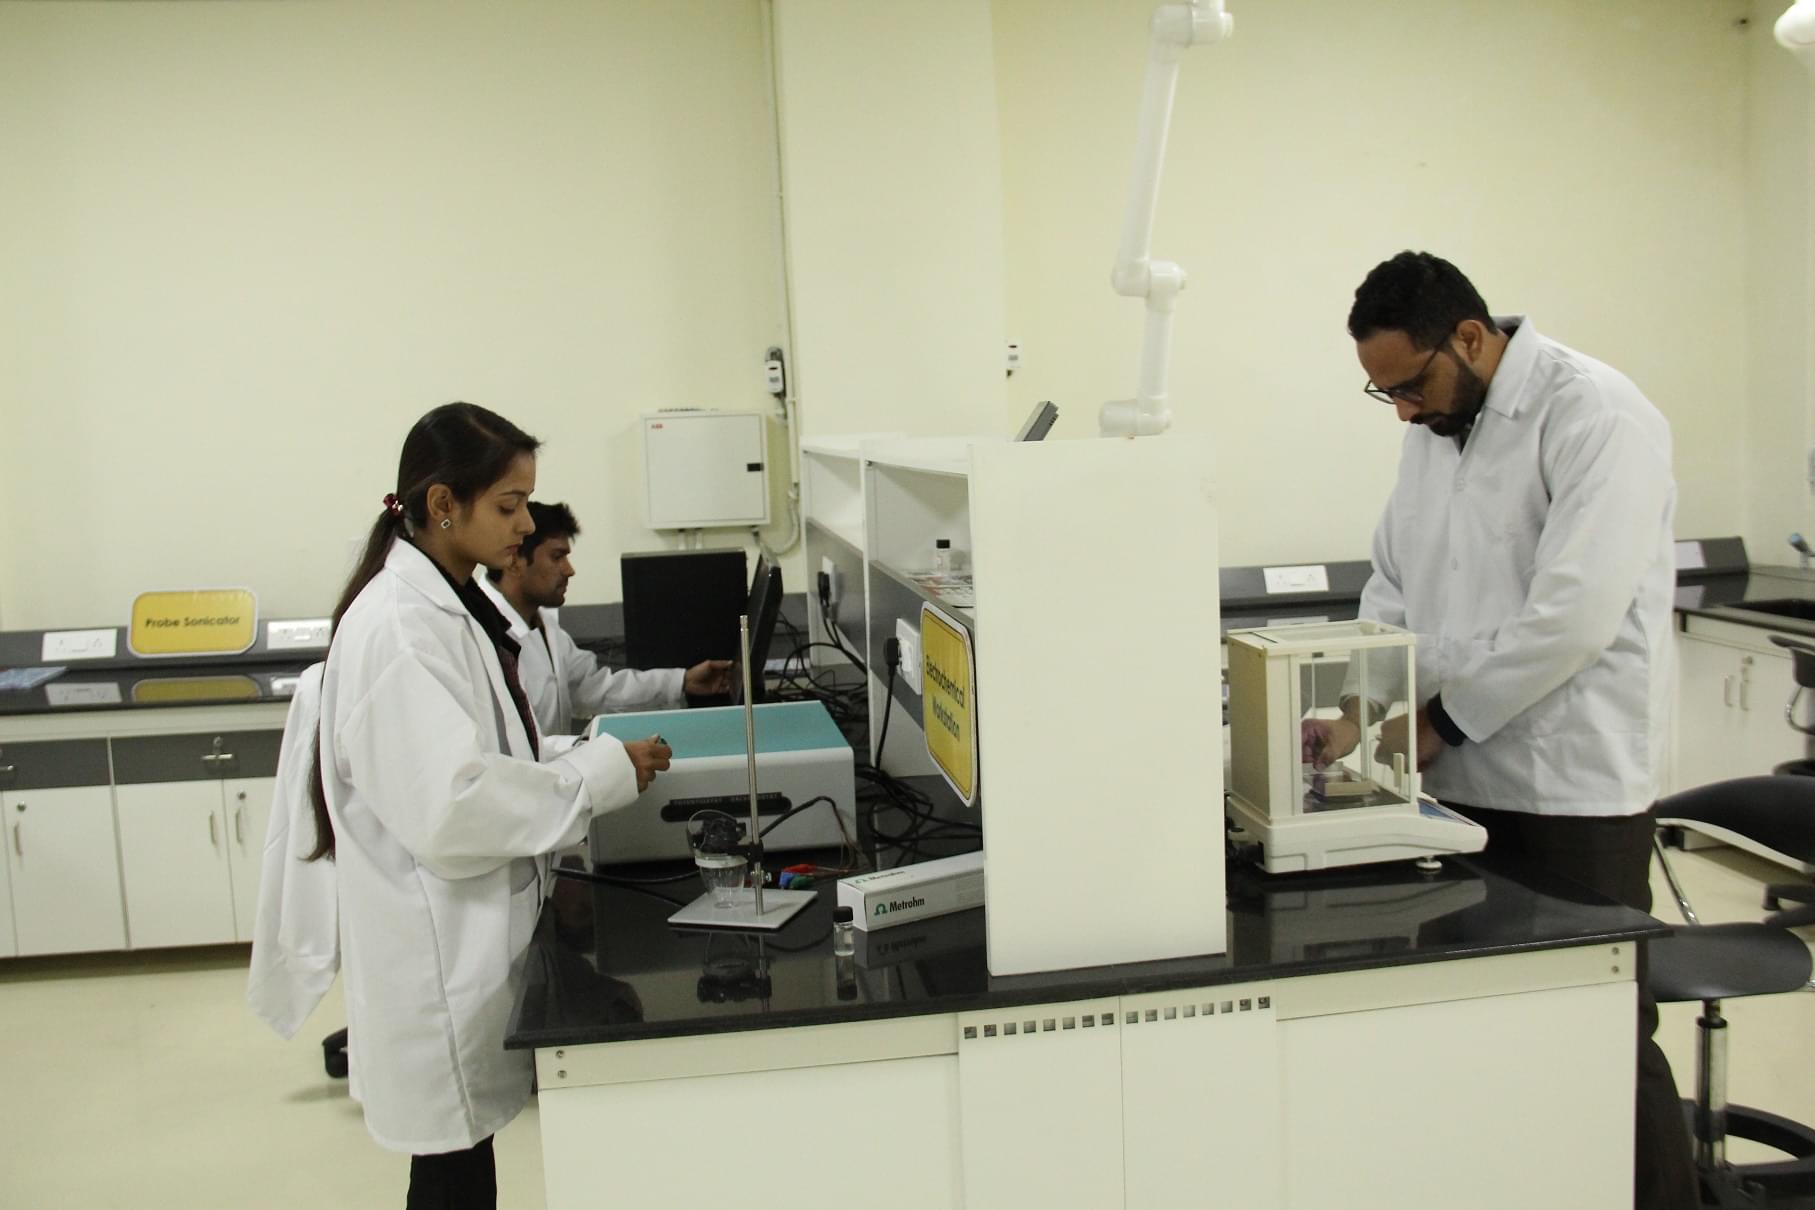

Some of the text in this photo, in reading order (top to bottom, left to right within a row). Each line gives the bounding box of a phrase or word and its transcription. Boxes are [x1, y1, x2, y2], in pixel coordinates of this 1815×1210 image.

[145, 616, 240, 628] Probe Sonicator
[926, 654, 965, 709] Electrochemical
[889, 897, 925, 913] Metrohm
